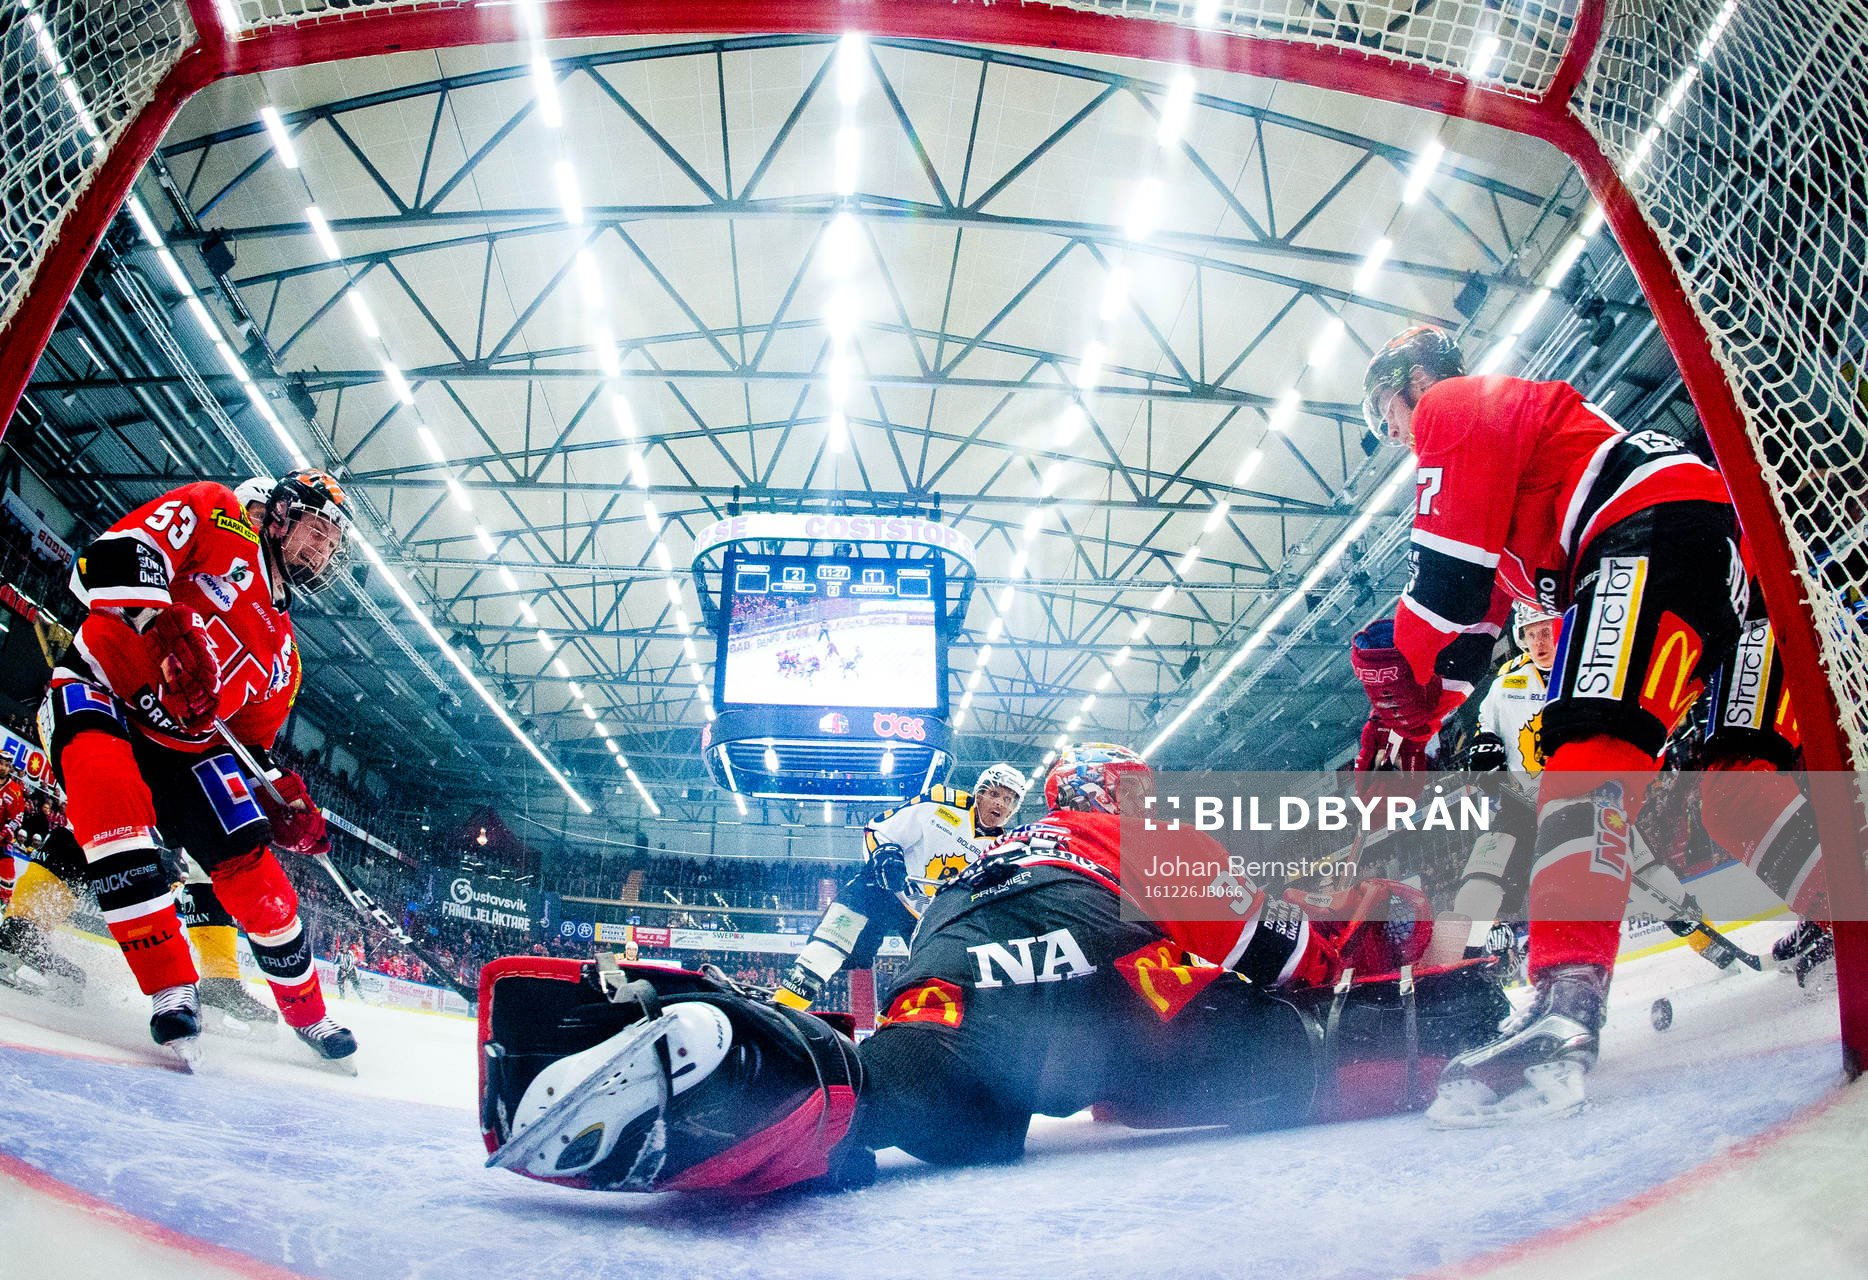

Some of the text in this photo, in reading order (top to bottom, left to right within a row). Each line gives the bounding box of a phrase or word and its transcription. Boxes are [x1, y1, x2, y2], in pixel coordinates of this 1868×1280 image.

[145, 500, 198, 550] 53
[1577, 559, 1634, 694] Structor
[873, 712, 926, 741] ÖGS
[93, 826, 133, 842] BAUER
[450, 878, 528, 912] Gustavsvik
[971, 871, 1032, 901] PREMIER
[441, 900, 532, 931] FAMILJELÄKTARE
[119, 930, 173, 953] STILL
[966, 927, 1098, 989] NA
